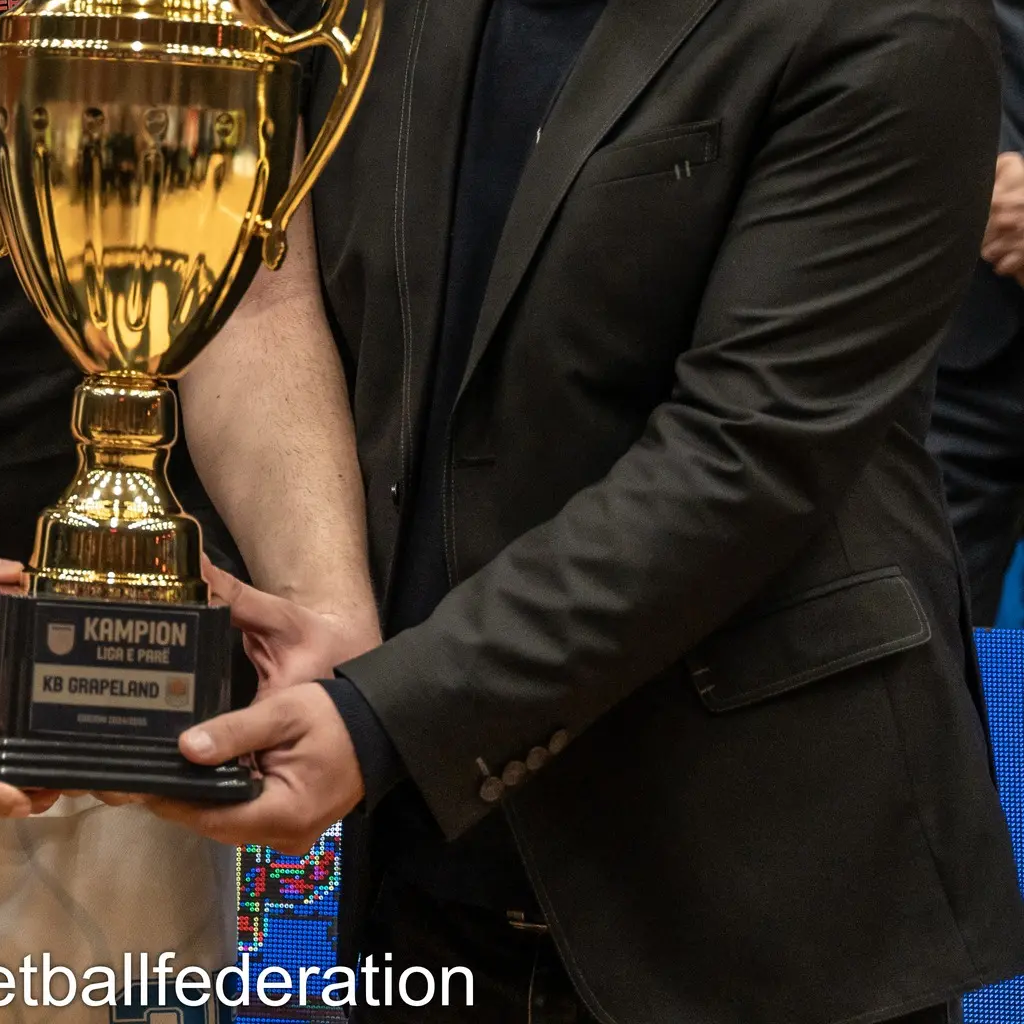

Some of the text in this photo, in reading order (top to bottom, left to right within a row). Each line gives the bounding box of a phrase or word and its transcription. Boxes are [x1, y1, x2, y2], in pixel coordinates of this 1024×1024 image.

[84, 616, 187, 647] KAMPION
[96, 646, 170, 664] LIGA E PARË
[43, 676, 160, 699] KB GRAPELAND
